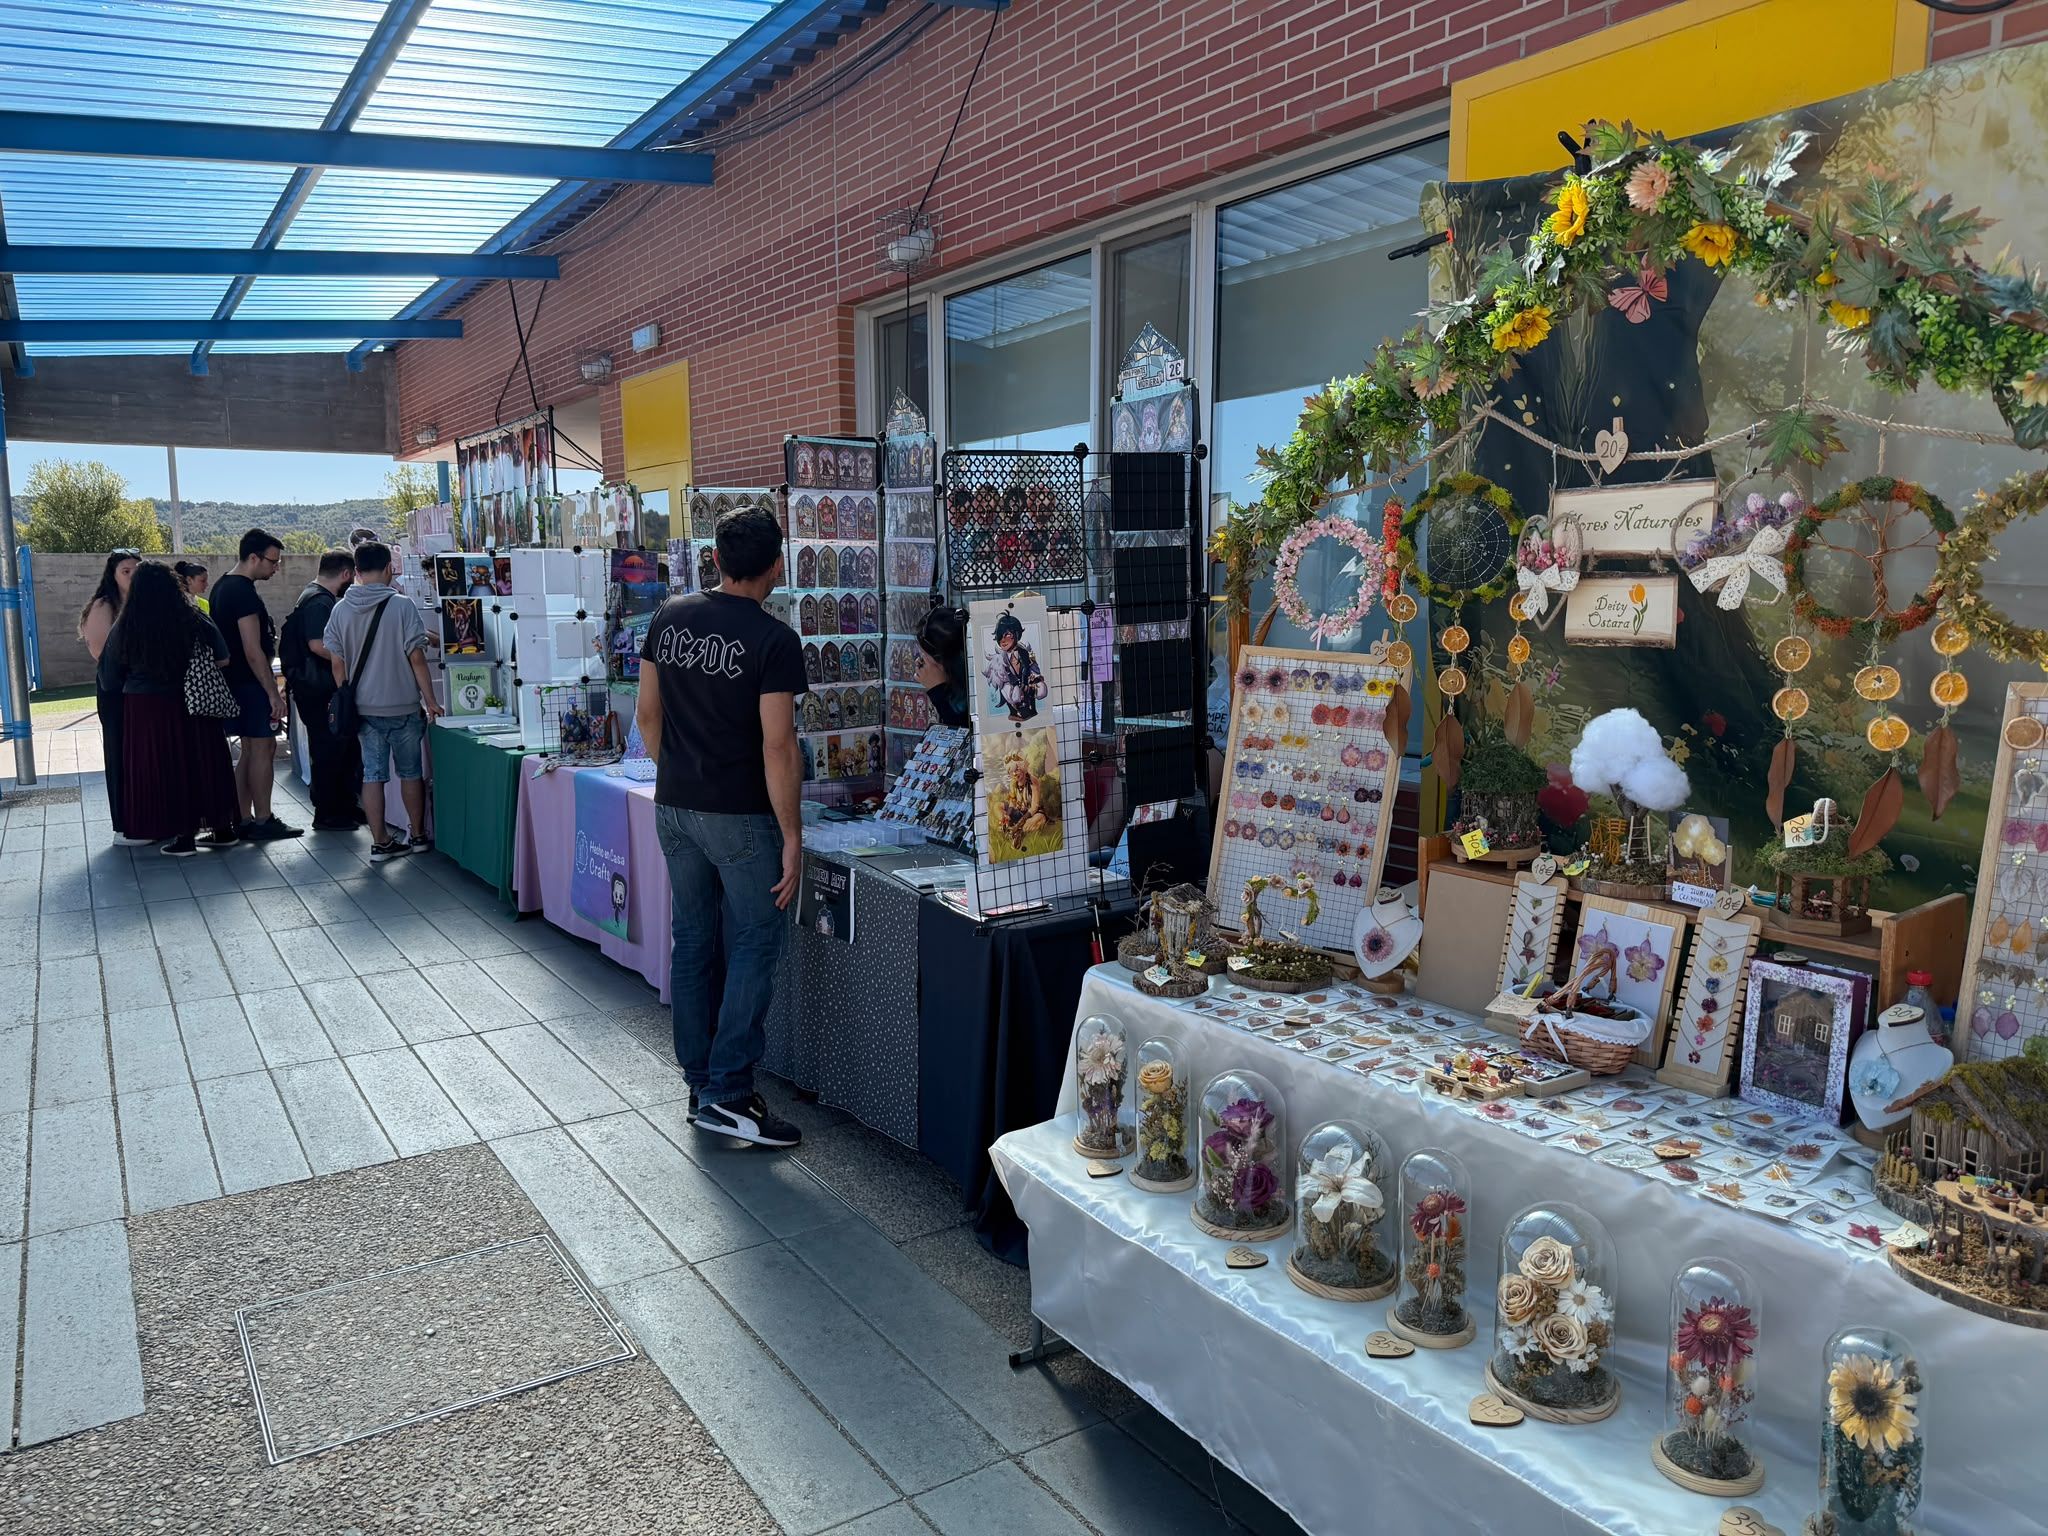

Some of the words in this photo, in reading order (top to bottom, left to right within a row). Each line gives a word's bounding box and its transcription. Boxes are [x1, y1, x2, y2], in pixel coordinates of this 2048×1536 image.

[1169, 362, 1182, 377] 2€
[1600, 440, 1626, 459] 20€
[1594, 593, 1629, 618] Deity
[1588, 610, 1631, 630] Ostara
[1468, 834, 1484, 857] 40€
[589, 857, 611, 882] Crafts
[1534, 863, 1554, 876] 18€
[1717, 895, 1742, 911] 18€
[1367, 1335, 1408, 1354] 35€
